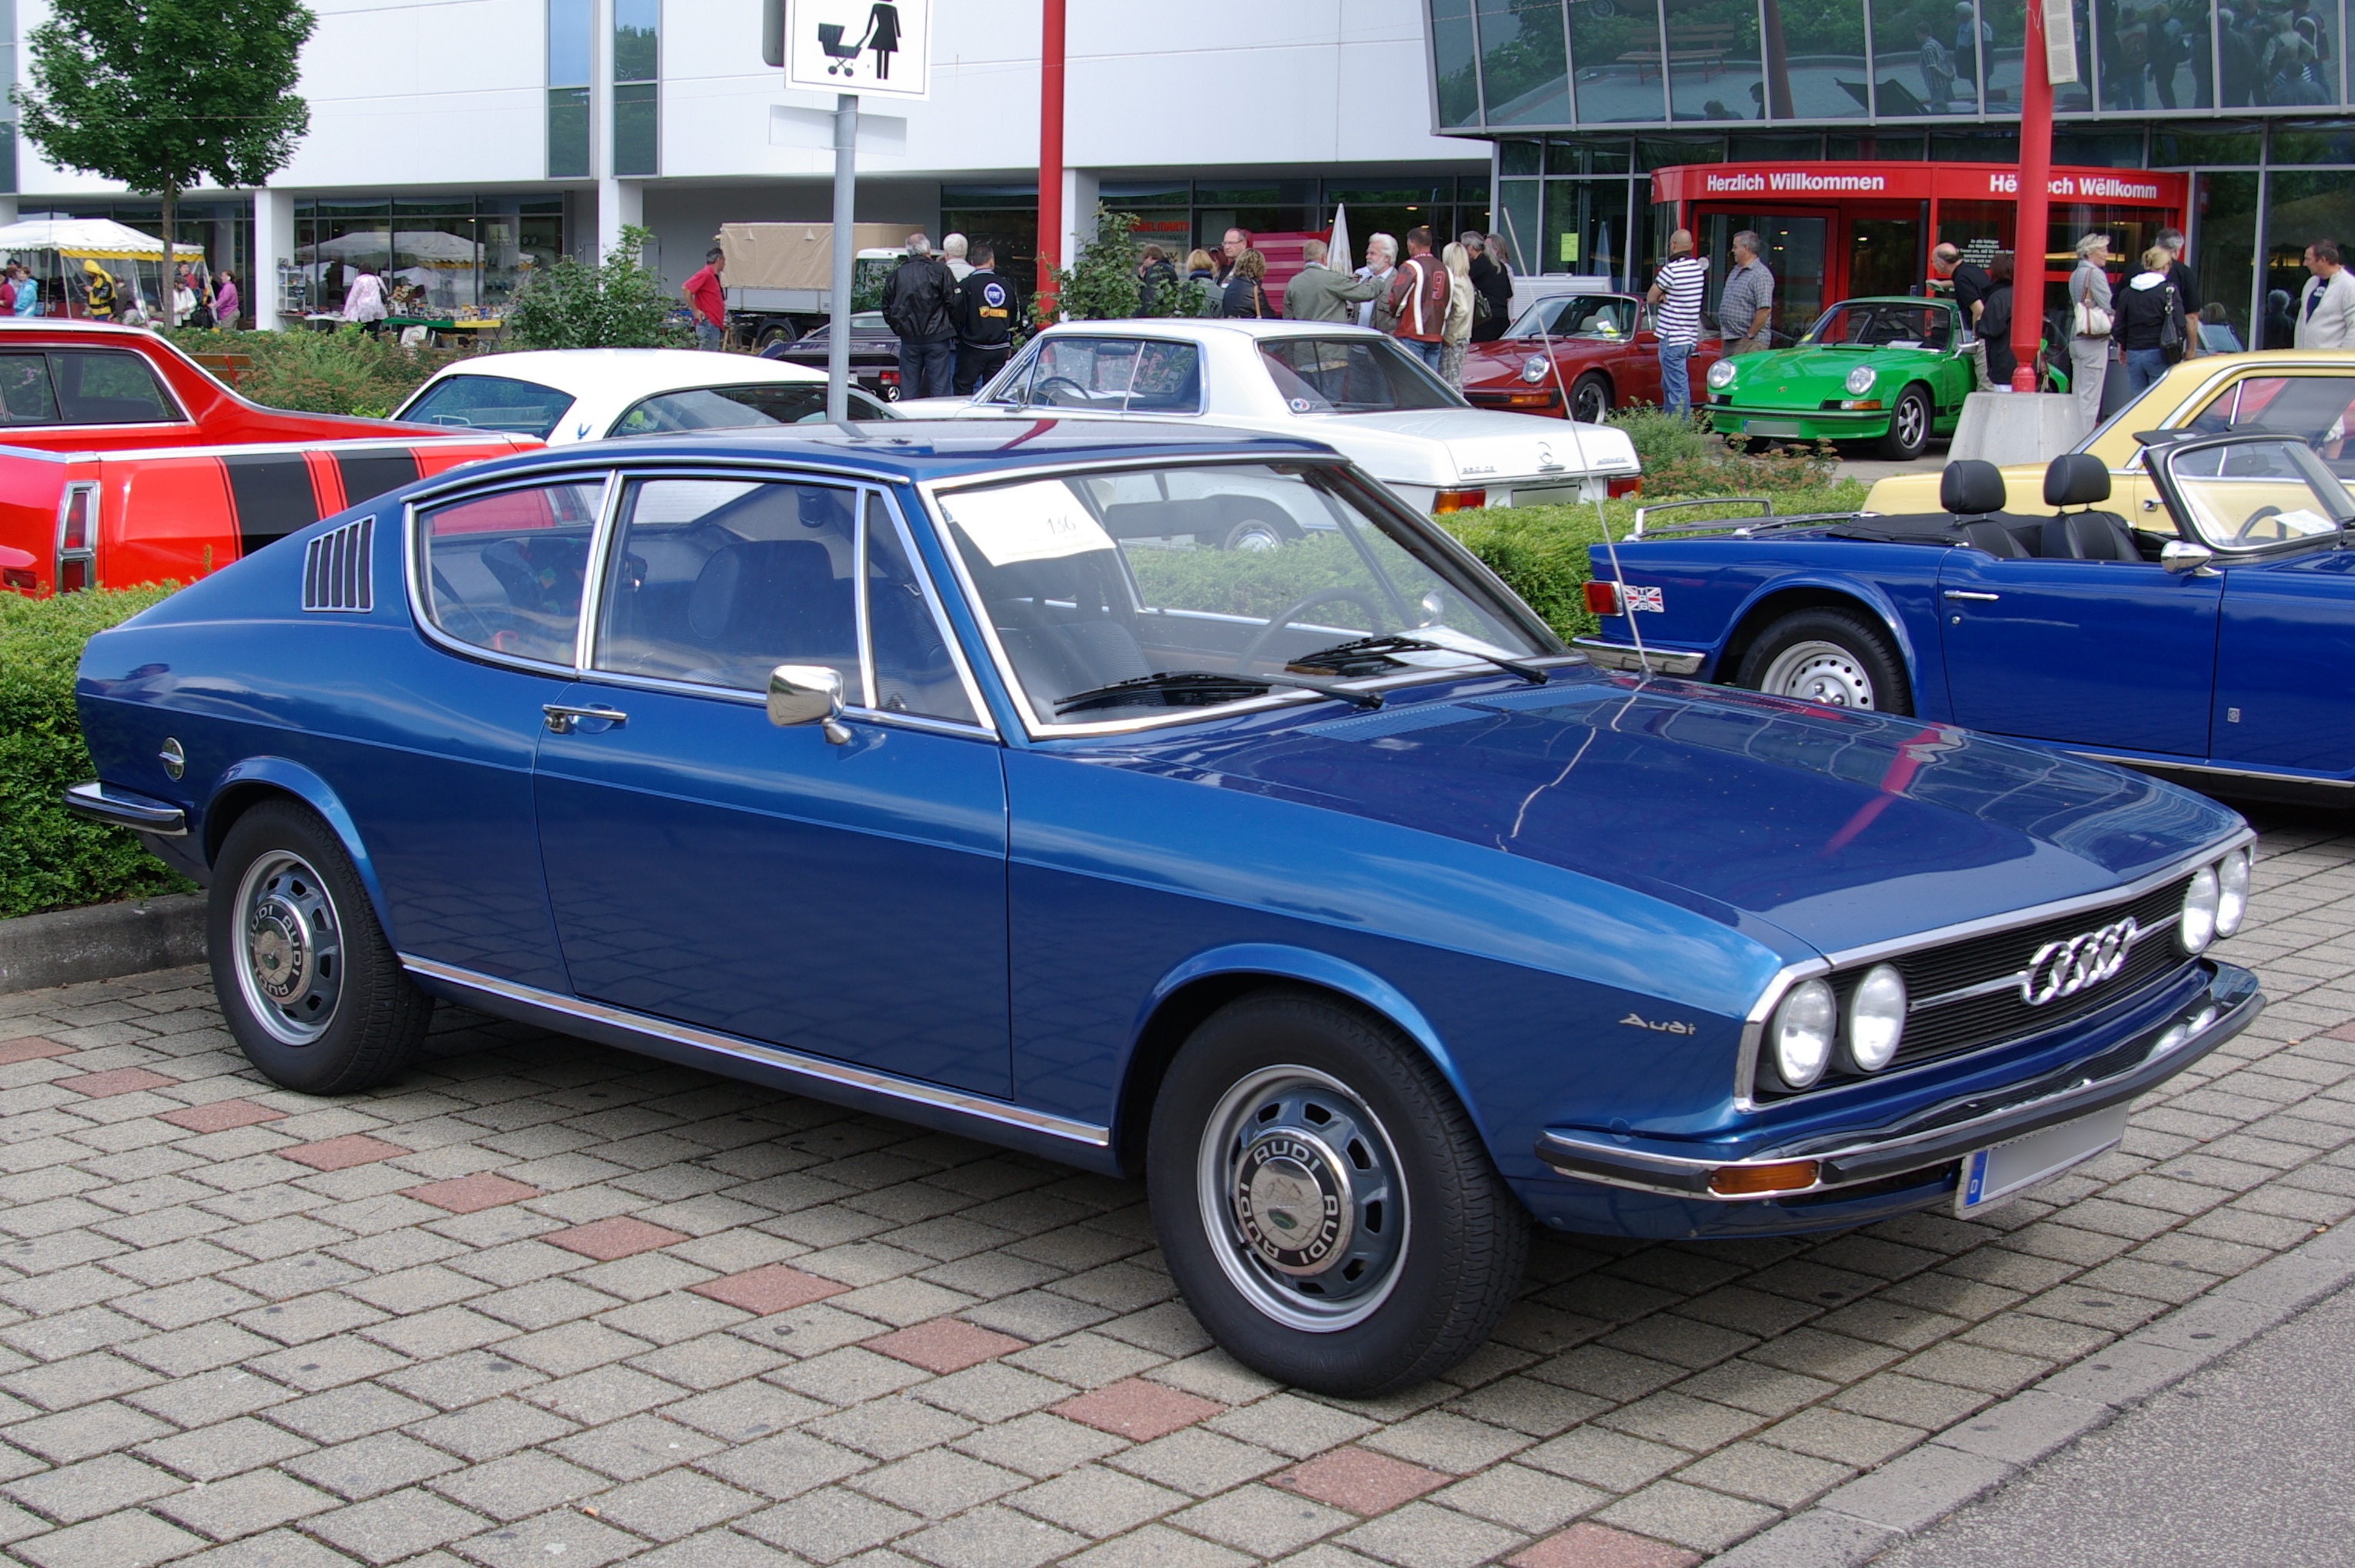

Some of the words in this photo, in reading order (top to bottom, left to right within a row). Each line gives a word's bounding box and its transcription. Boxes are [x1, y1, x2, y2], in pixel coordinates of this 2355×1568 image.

[1707, 174, 1764, 191] Herzlich
[1769, 173, 1884, 191] Willkommen
[2079, 177, 2157, 199] Wëllkomm
[1432, 271, 1446, 300] 9
[1046, 514, 1077, 535] 136
[281, 914, 302, 977] AUDI
[255, 967, 289, 996] AUDI
[1618, 1013, 1697, 1035] Audi
[1253, 1140, 1321, 1171] AUDI
[1969, 1179, 1977, 1194] D
[1240, 1182, 1280, 1259] AUDI
[1299, 1194, 1339, 1264] AUDI
